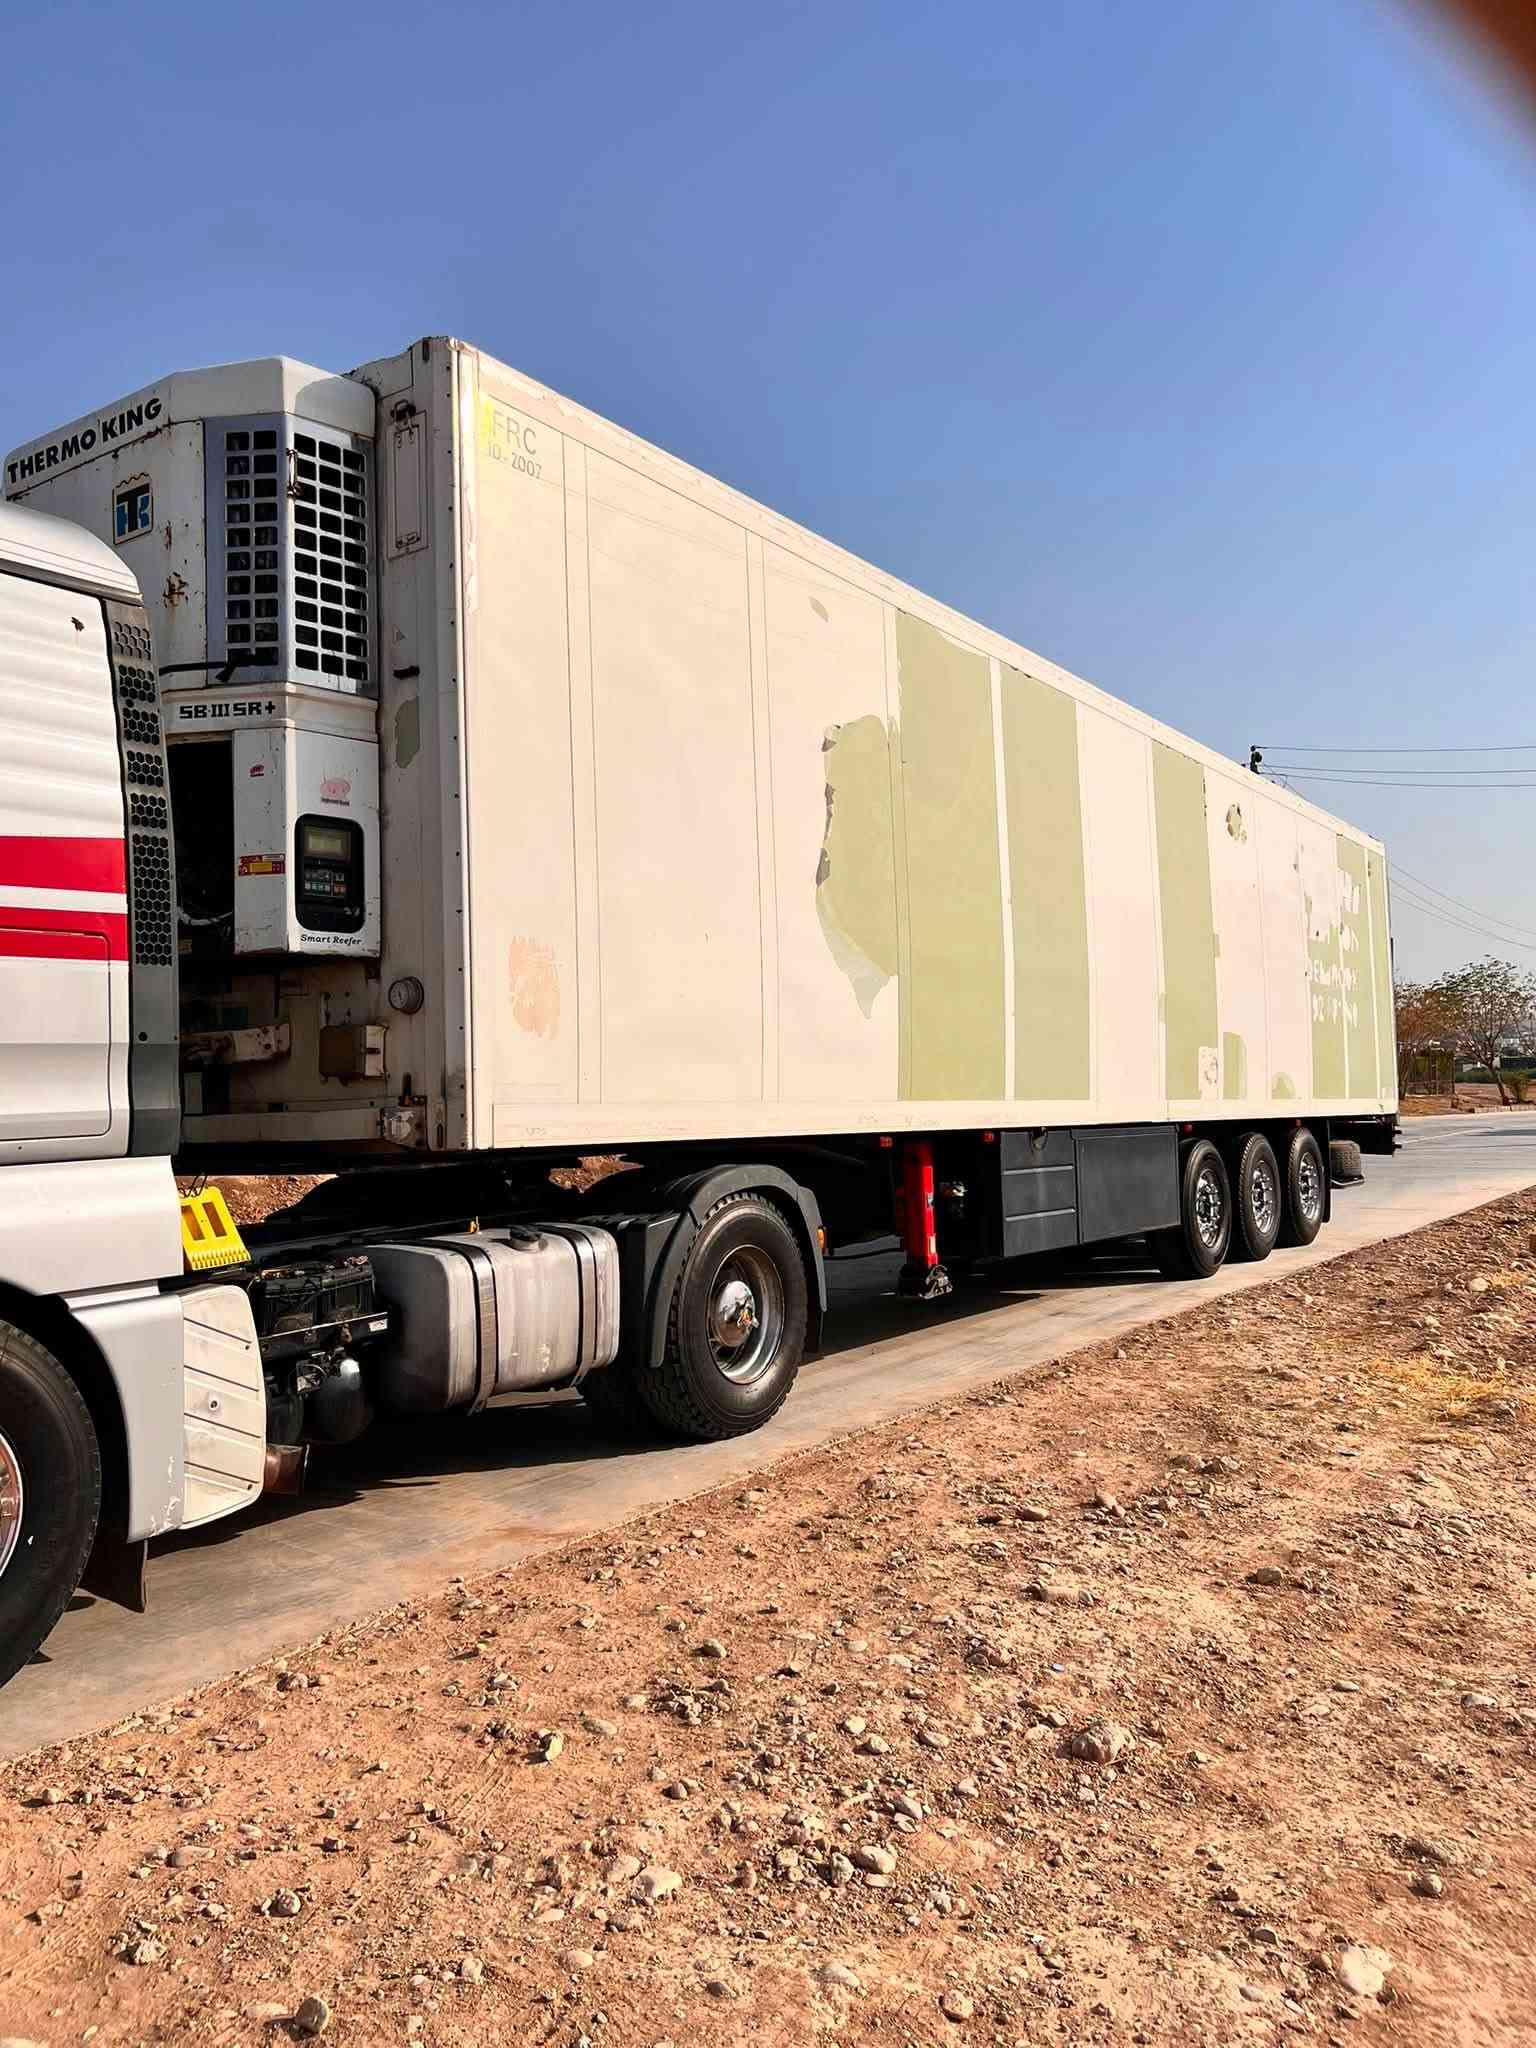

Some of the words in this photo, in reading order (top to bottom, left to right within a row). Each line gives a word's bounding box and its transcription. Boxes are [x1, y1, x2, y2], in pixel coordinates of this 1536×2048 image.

[7, 428, 97, 484] THERMO
[101, 398, 162, 443] KING
[300, 934, 331, 944] Smart
[332, 935, 362, 947] Reefer
